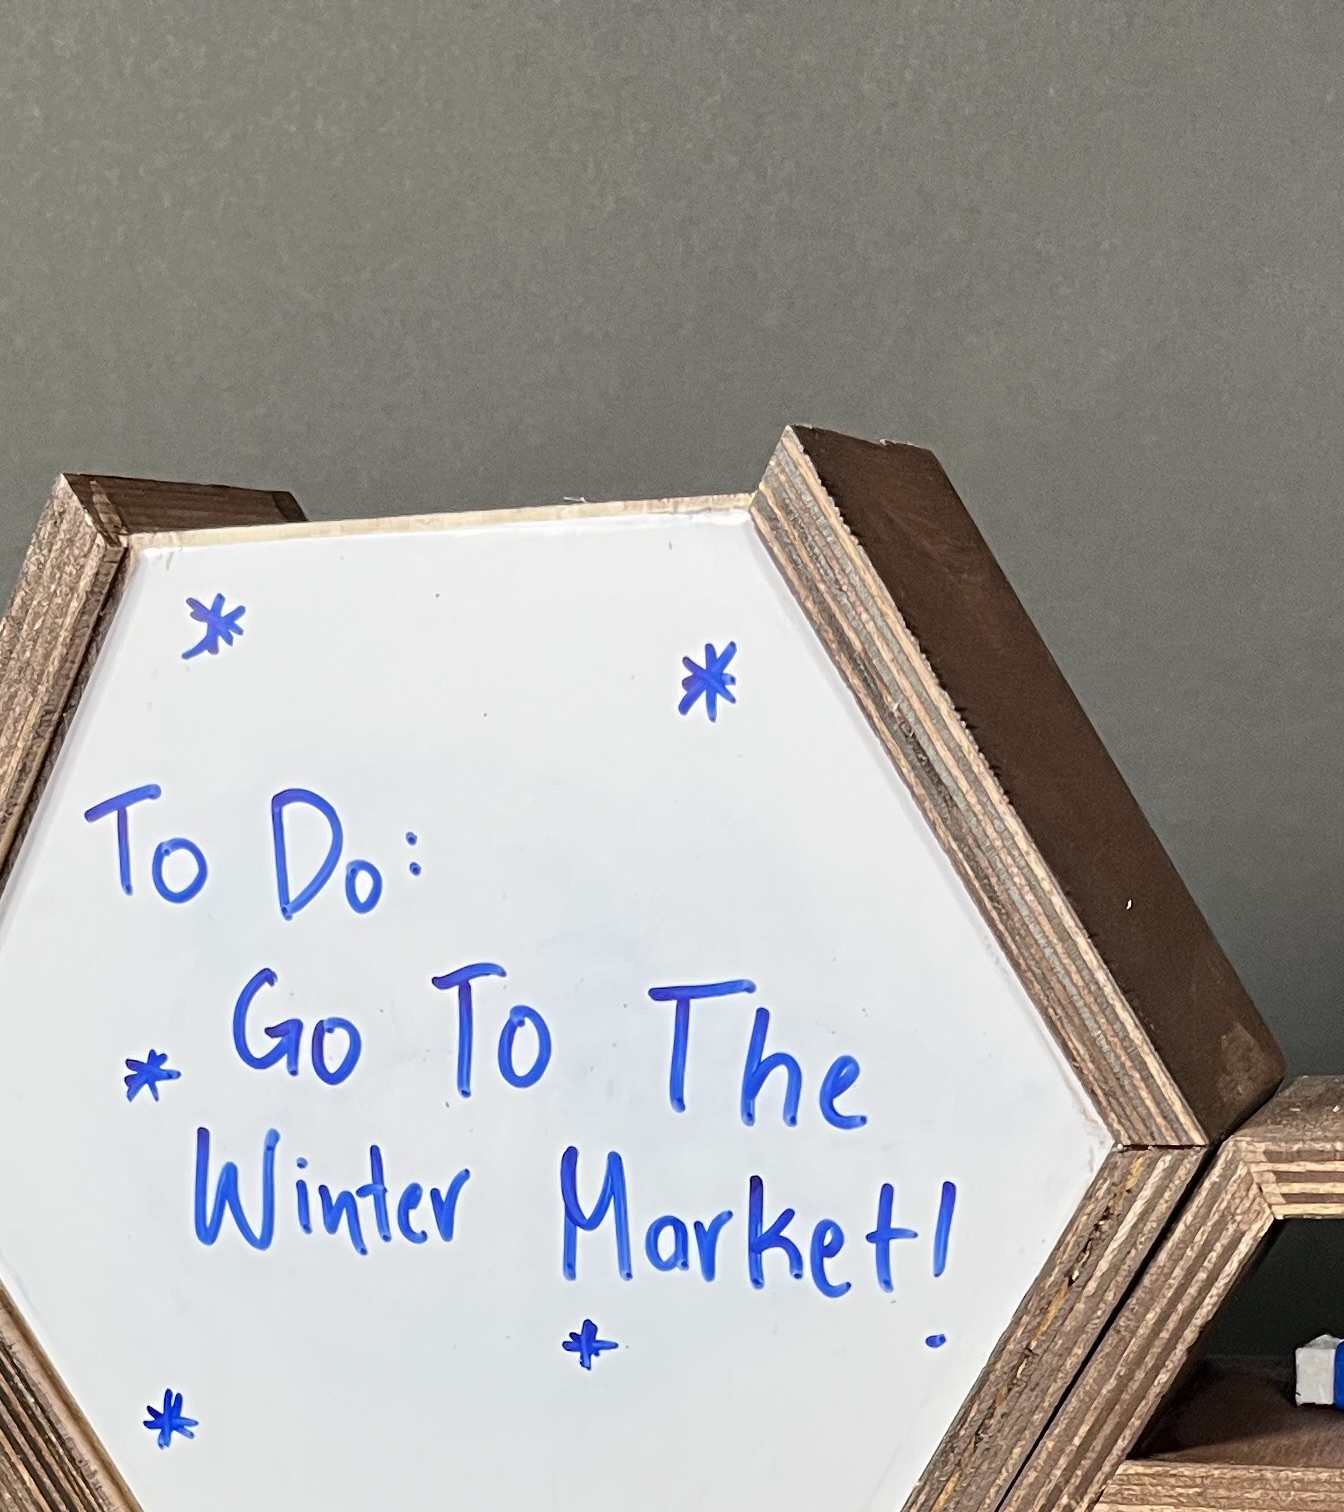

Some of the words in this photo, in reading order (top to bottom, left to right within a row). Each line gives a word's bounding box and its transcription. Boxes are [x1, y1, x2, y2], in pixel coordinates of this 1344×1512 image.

[84, 783, 209, 904] To
[270, 788, 422, 921] Do:
[232, 967, 363, 1086] Go
[431, 961, 553, 1099] To
[647, 978, 868, 1131] The
[193, 1126, 471, 1256] Winter
[559, 1145, 957, 1349] Market!
